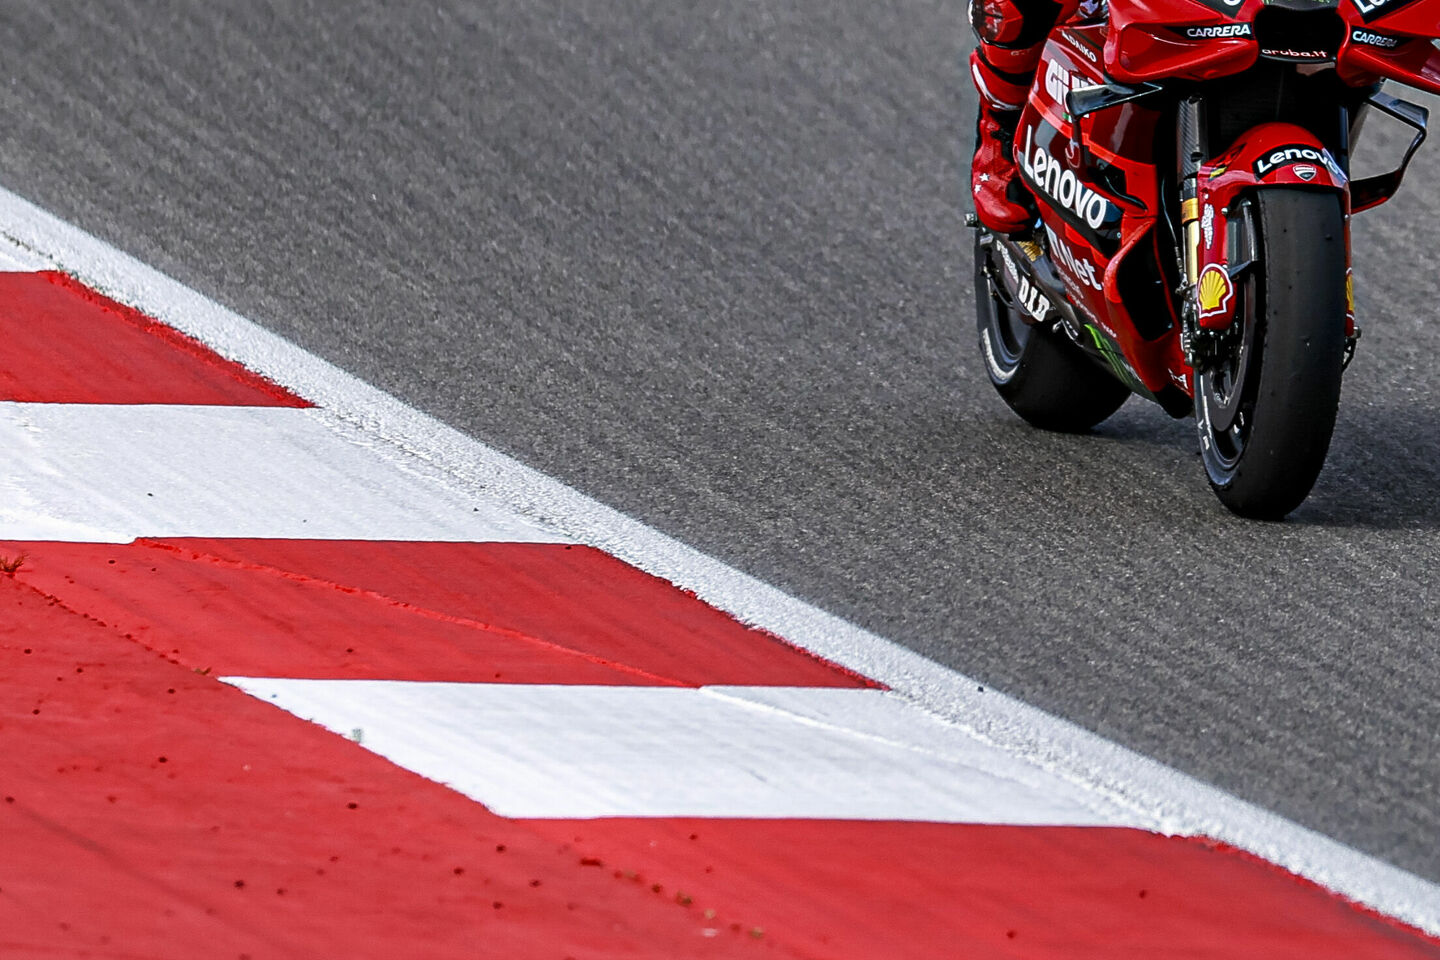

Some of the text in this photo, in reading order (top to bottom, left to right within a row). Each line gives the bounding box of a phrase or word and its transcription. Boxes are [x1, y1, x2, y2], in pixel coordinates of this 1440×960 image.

[1186, 24, 1252, 38] CARRERA
[1024, 124, 1108, 230] Lenovo
[1256, 147, 1343, 177] Lenovo
